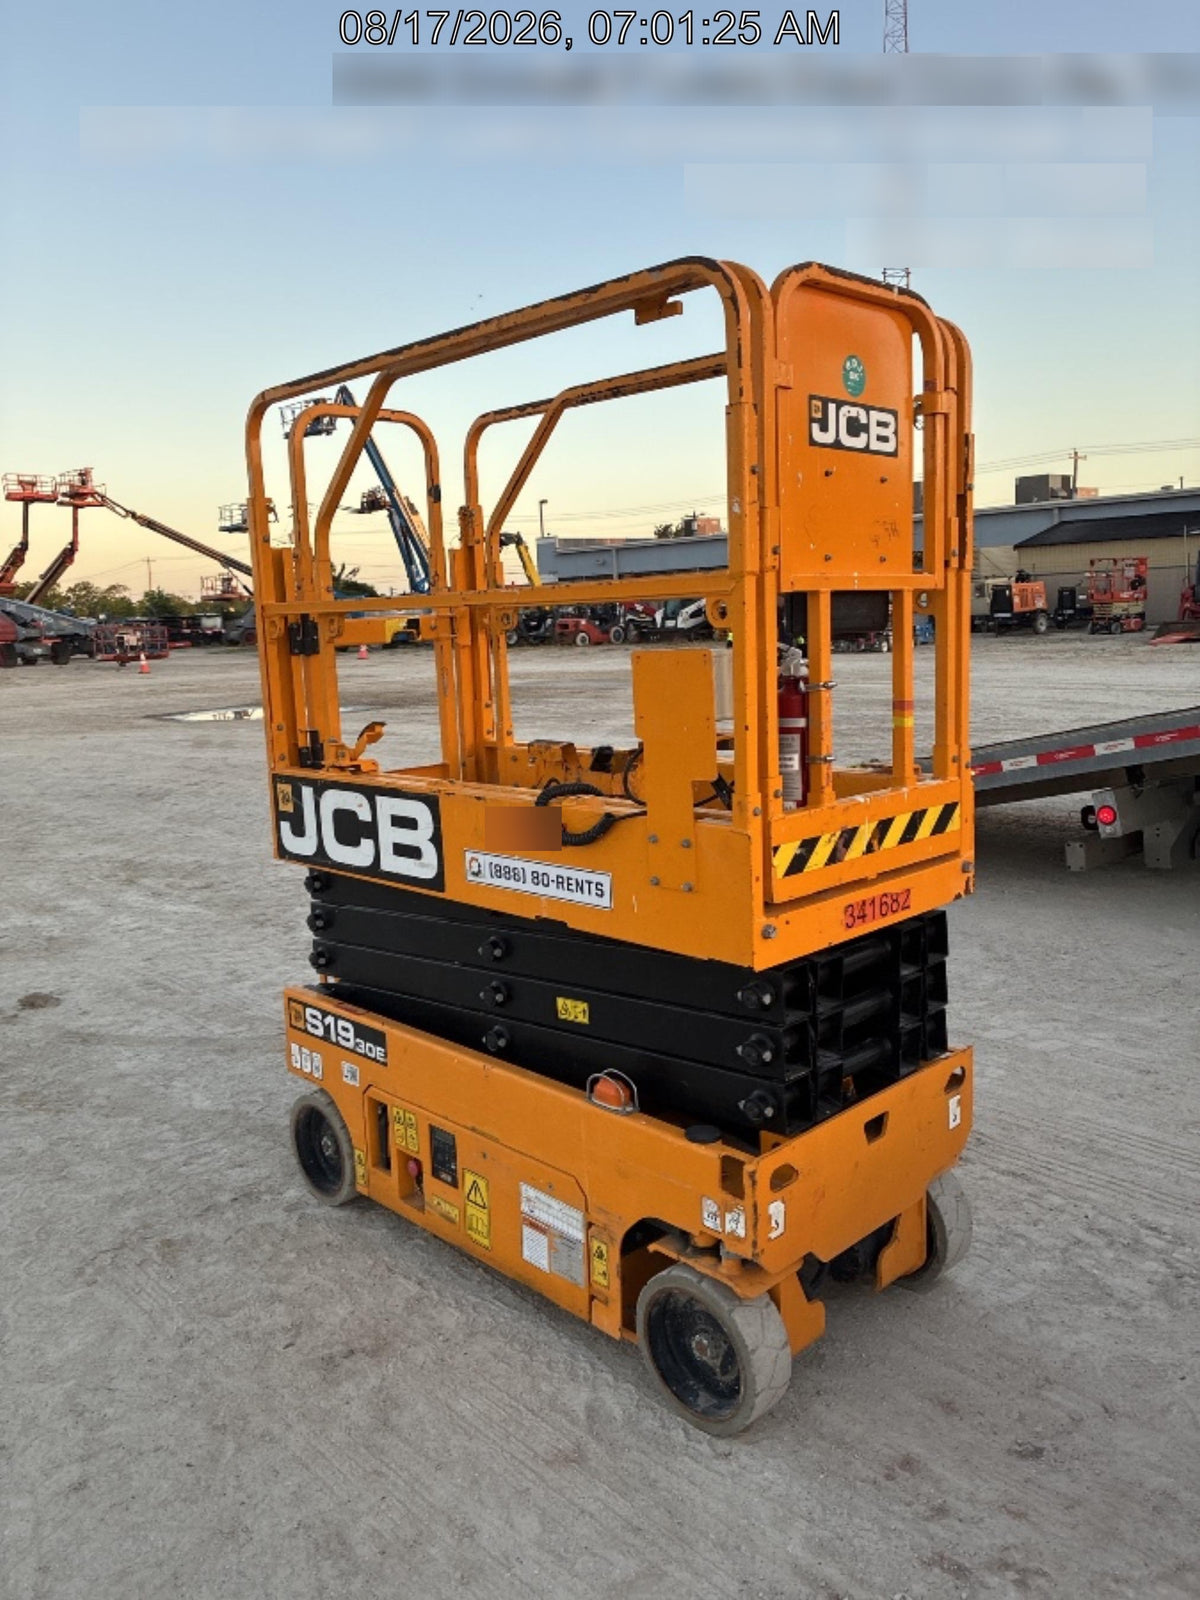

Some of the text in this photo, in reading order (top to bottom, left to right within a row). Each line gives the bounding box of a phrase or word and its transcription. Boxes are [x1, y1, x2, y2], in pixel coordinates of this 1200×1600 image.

[811, 402, 897, 452] JCB
[280, 786, 438, 879] JCB
[489, 862, 605, 898] (888) 80-RENTS
[844, 889, 911, 928] 341682
